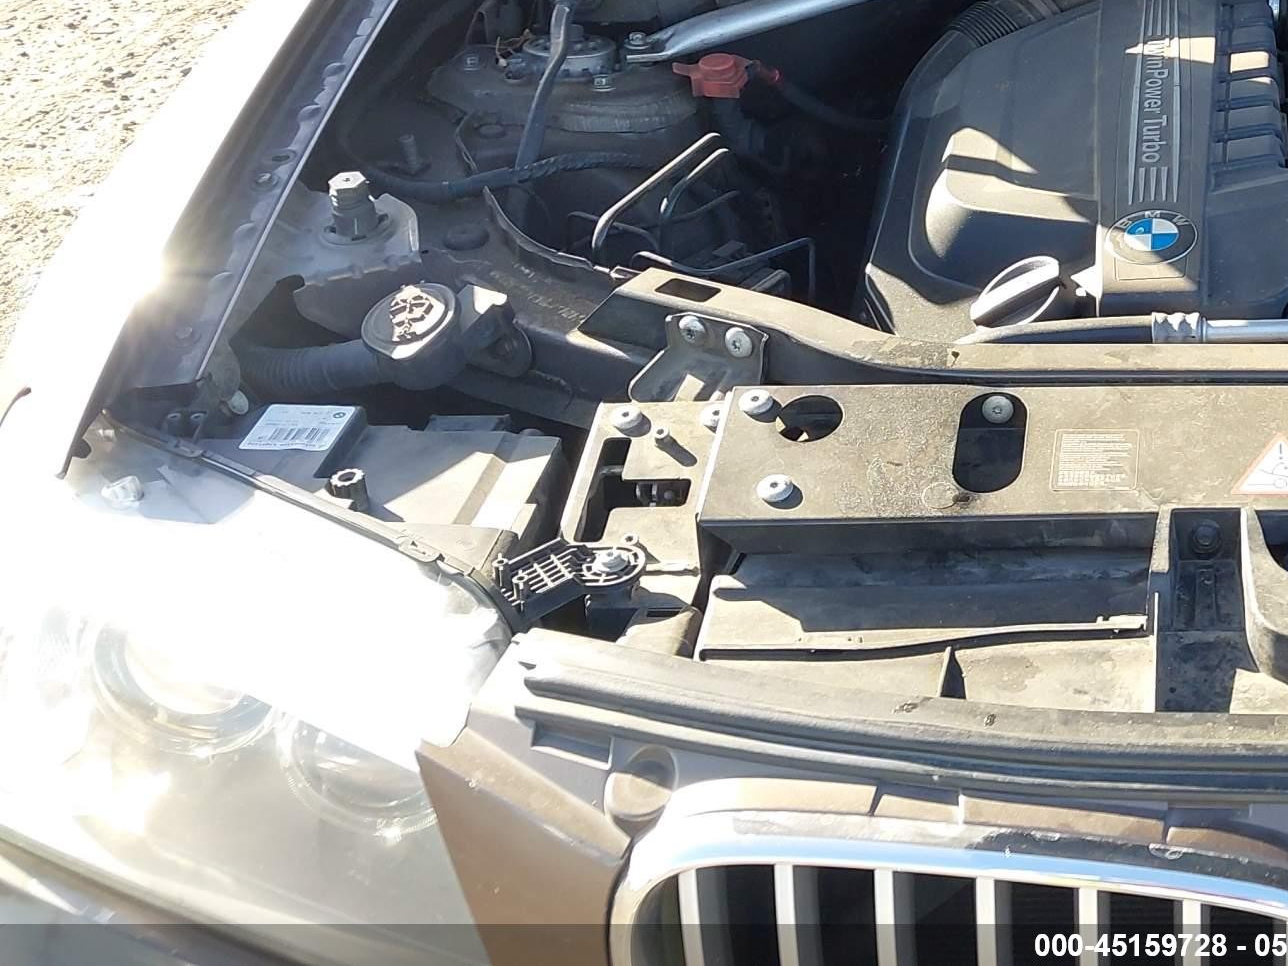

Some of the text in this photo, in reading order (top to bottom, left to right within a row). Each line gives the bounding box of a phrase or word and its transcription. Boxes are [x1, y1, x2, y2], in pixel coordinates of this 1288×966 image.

[1141, 37, 1170, 163] TwinPower Turbo
[1118, 210, 1191, 229] BMW
